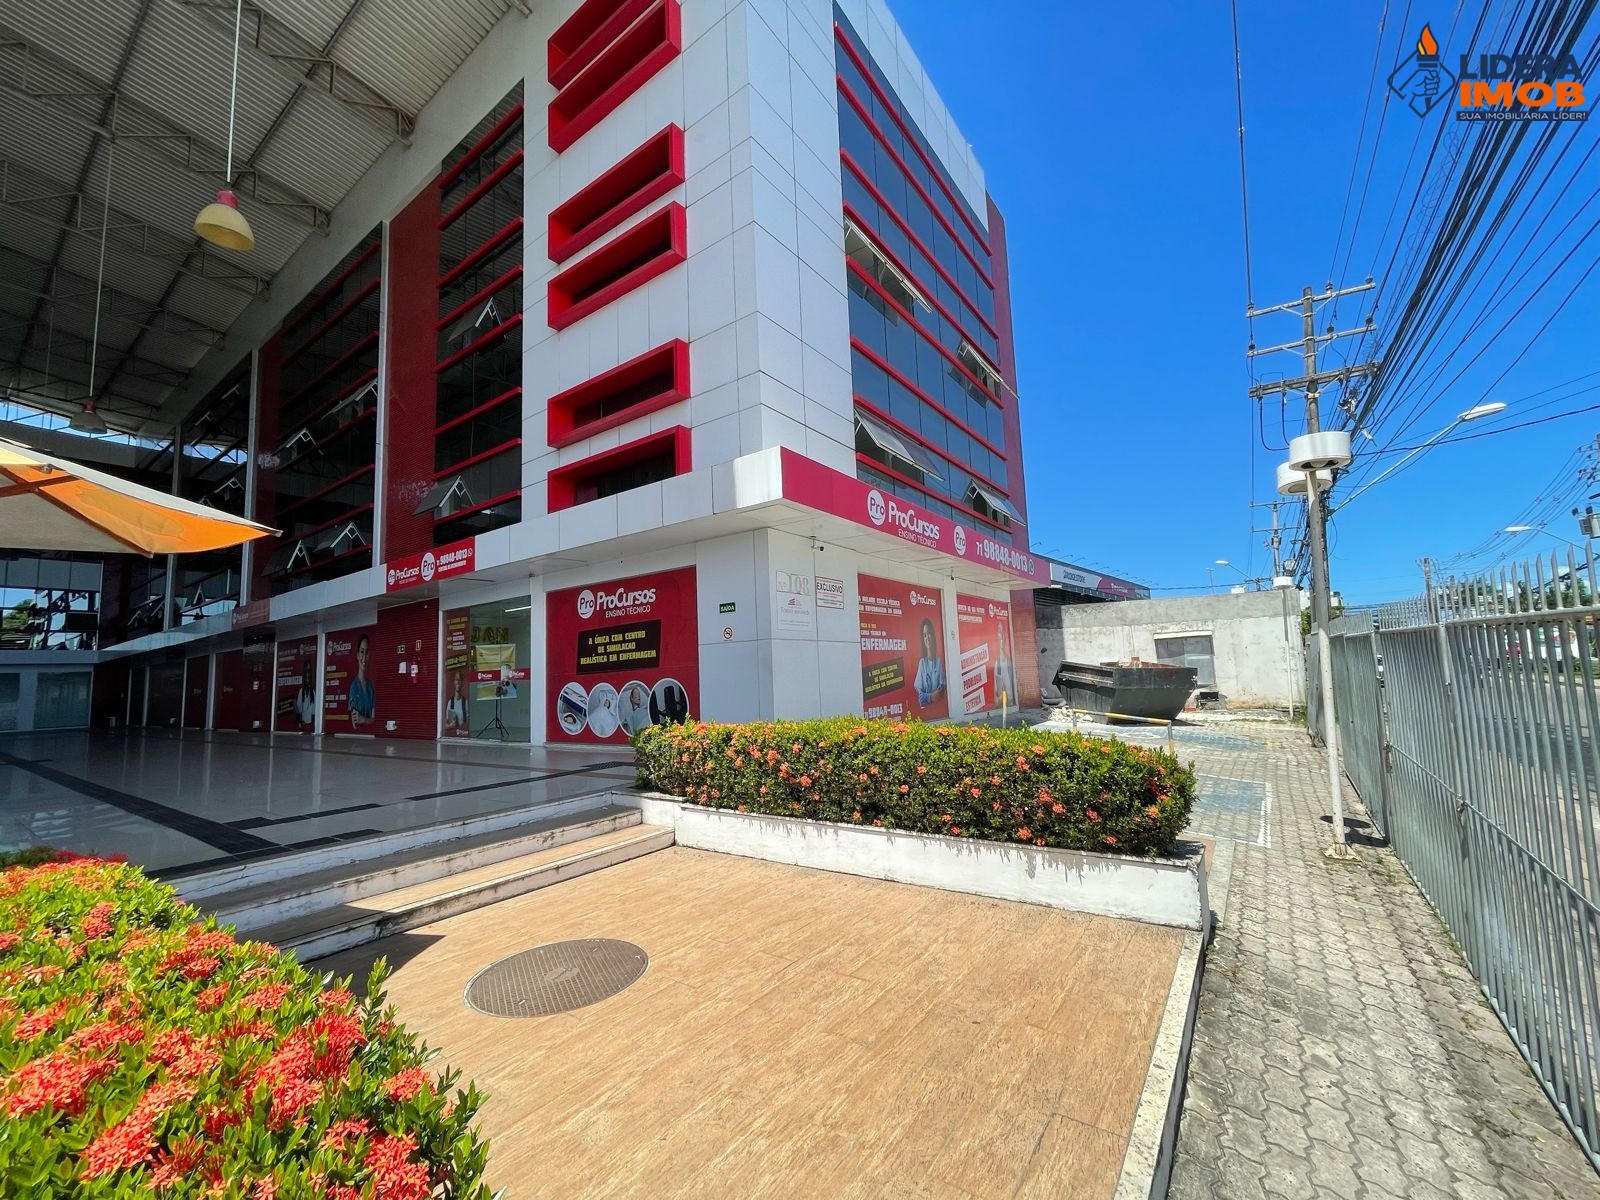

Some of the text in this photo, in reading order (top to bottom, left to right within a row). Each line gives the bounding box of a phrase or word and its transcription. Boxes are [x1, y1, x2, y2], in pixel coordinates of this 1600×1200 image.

[870, 496, 940, 540] Pro ProCursos
[898, 528, 937, 548] ENSINO TÉCNICO
[976, 541, 983, 556] 71
[983, 539, 1028, 572] 98848-0013
[395, 566, 420, 581] ProCursos
[816, 581, 843, 595] EXCLUSIVO
[579, 587, 657, 611] Pro ProCursos
[605, 604, 651, 618] ENSINO TÉCNICO
[720, 604, 736, 613] SAÍDA
[624, 630, 646, 640] CENTRO
[597, 645, 605, 653] DE
[861, 637, 907, 651] ENFERMAGEM
[619, 649, 657, 661] ENFERMAGEM
